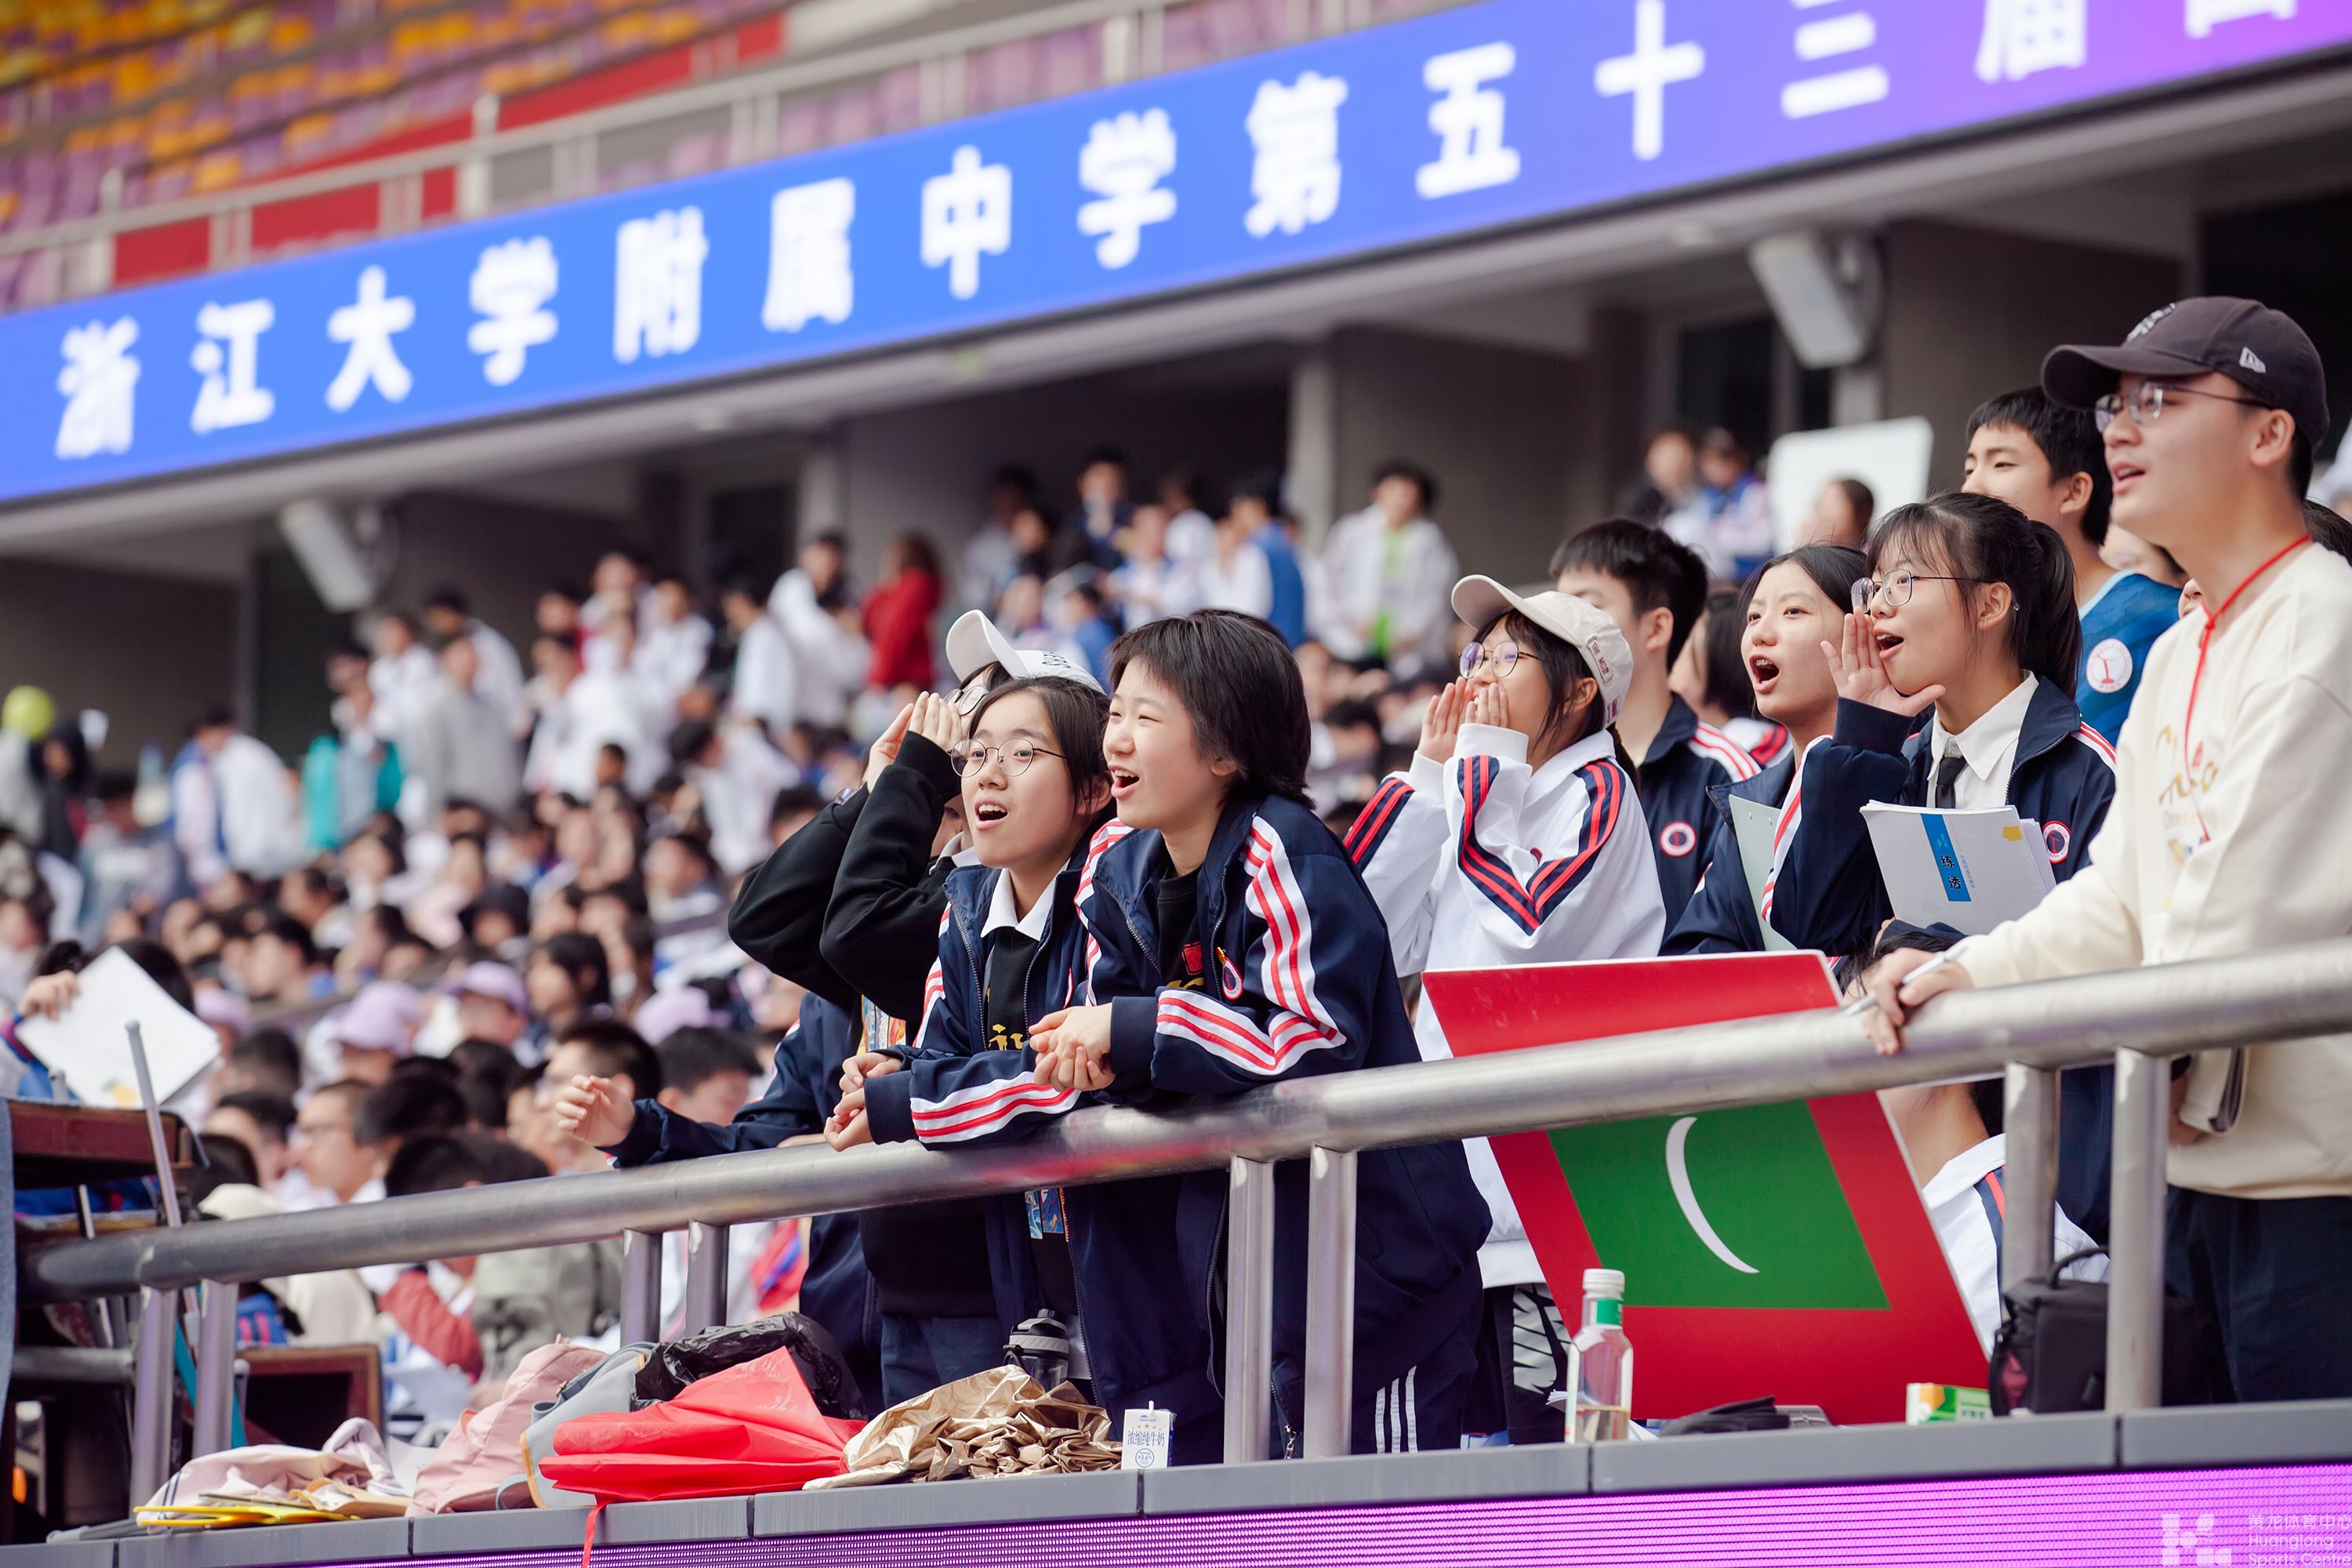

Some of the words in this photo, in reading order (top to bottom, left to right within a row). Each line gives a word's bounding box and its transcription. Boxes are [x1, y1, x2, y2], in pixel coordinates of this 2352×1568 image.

[1127, 1430, 1165, 1447] 浓缩纯牛奶
